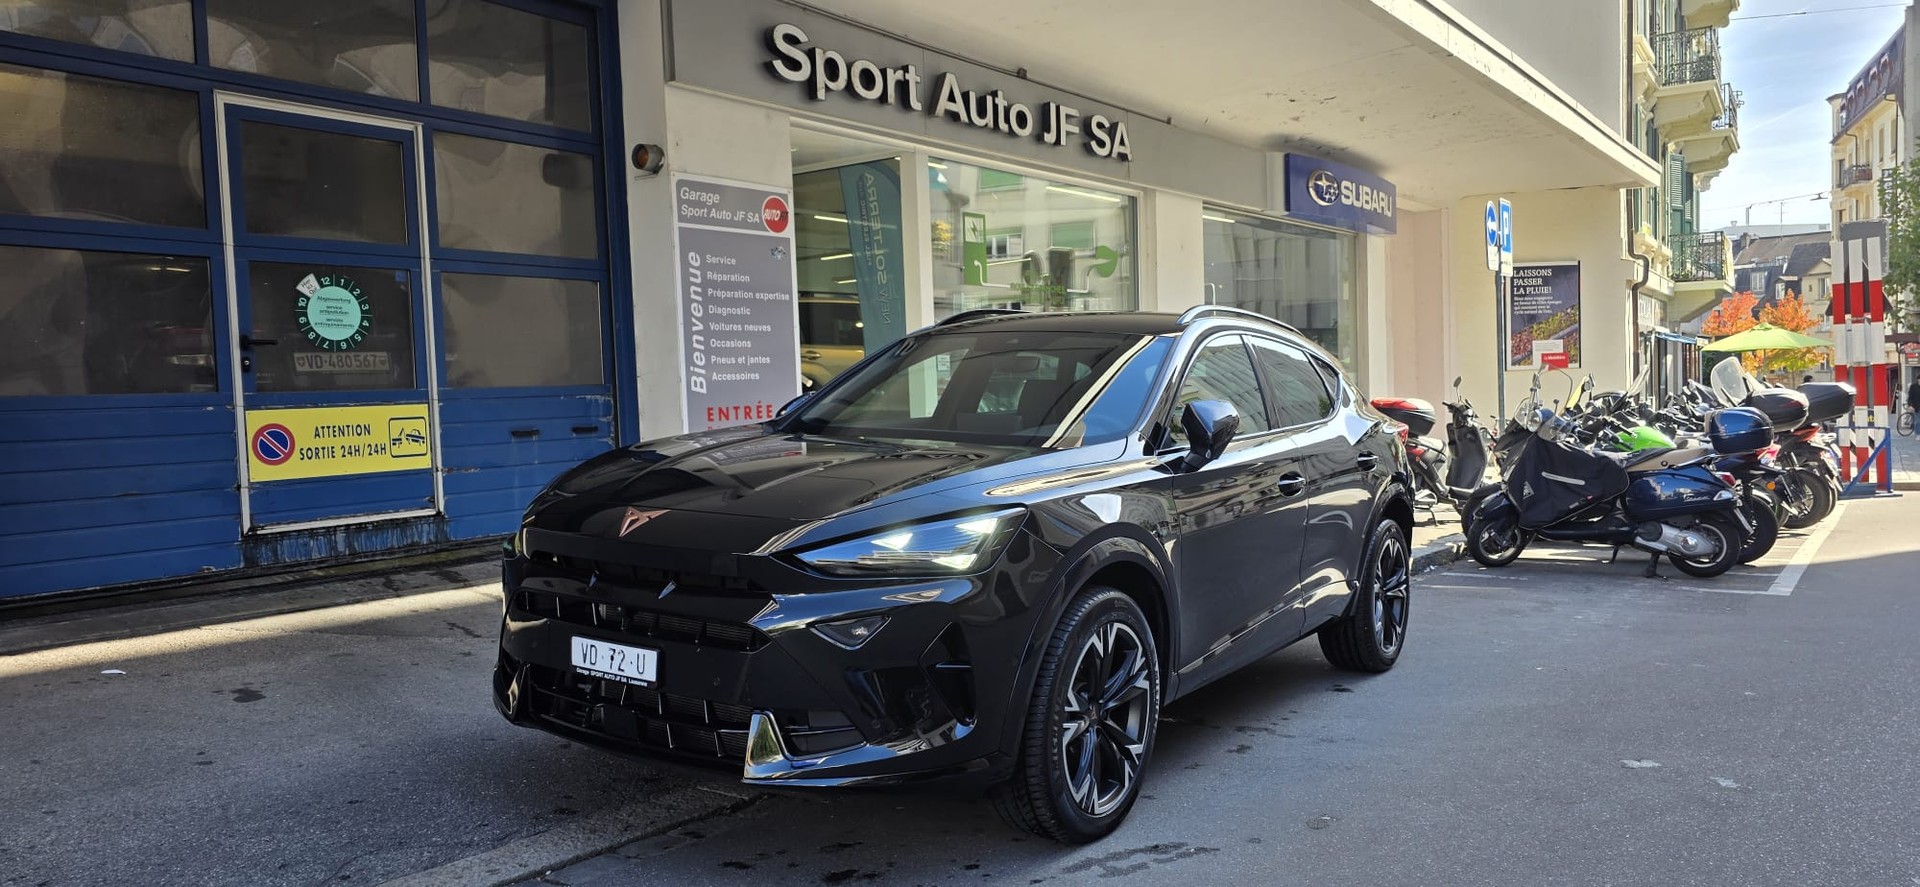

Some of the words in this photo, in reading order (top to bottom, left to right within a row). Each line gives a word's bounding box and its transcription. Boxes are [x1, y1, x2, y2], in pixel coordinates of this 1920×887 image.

[768, 23, 922, 112] Sport
[931, 71, 1034, 138] Auto
[1043, 101, 1080, 147] JF
[1090, 114, 1133, 162] SA
[680, 187, 720, 205] Garage
[1340, 180, 1392, 218] SUBARU
[681, 204, 707, 218] Sport
[709, 208, 732, 220] Auto
[733, 211, 746, 221] JF
[747, 212, 760, 223] SA
[706, 254, 736, 265] Service
[706, 271, 750, 283] Réparation
[1513, 269, 1553, 278] LAISSONS
[321, 277, 331, 285] 12
[1513, 278, 1543, 286] PASSER
[353, 288, 361, 296] 2
[707, 288, 754, 302] Préparation
[755, 291, 790, 302] expertise
[1513, 287, 1525, 295] LA
[1526, 286, 1552, 295] PLUIE!
[298, 297, 307, 307] 10
[708, 305, 751, 317] Diagnostic
[298, 316, 307, 324] 9
[688, 251, 707, 394] Bienvenue
[709, 322, 742, 331] Voitures
[744, 323, 771, 332] neuves
[307, 331, 316, 339] 8
[354, 333, 362, 342] 5
[323, 340, 330, 349] 7
[340, 341, 347, 350] 6
[710, 338, 752, 348] Occasions
[711, 355, 736, 365] Pneus
[737, 355, 746, 364] et
[747, 355, 771, 366] jantes
[712, 372, 760, 381] Accessoires
[707, 400, 773, 422] ENTRÉE
[314, 423, 371, 439] ATTENTION
[299, 446, 336, 460] SORTIE
[340, 442, 387, 458] 24H/24H
